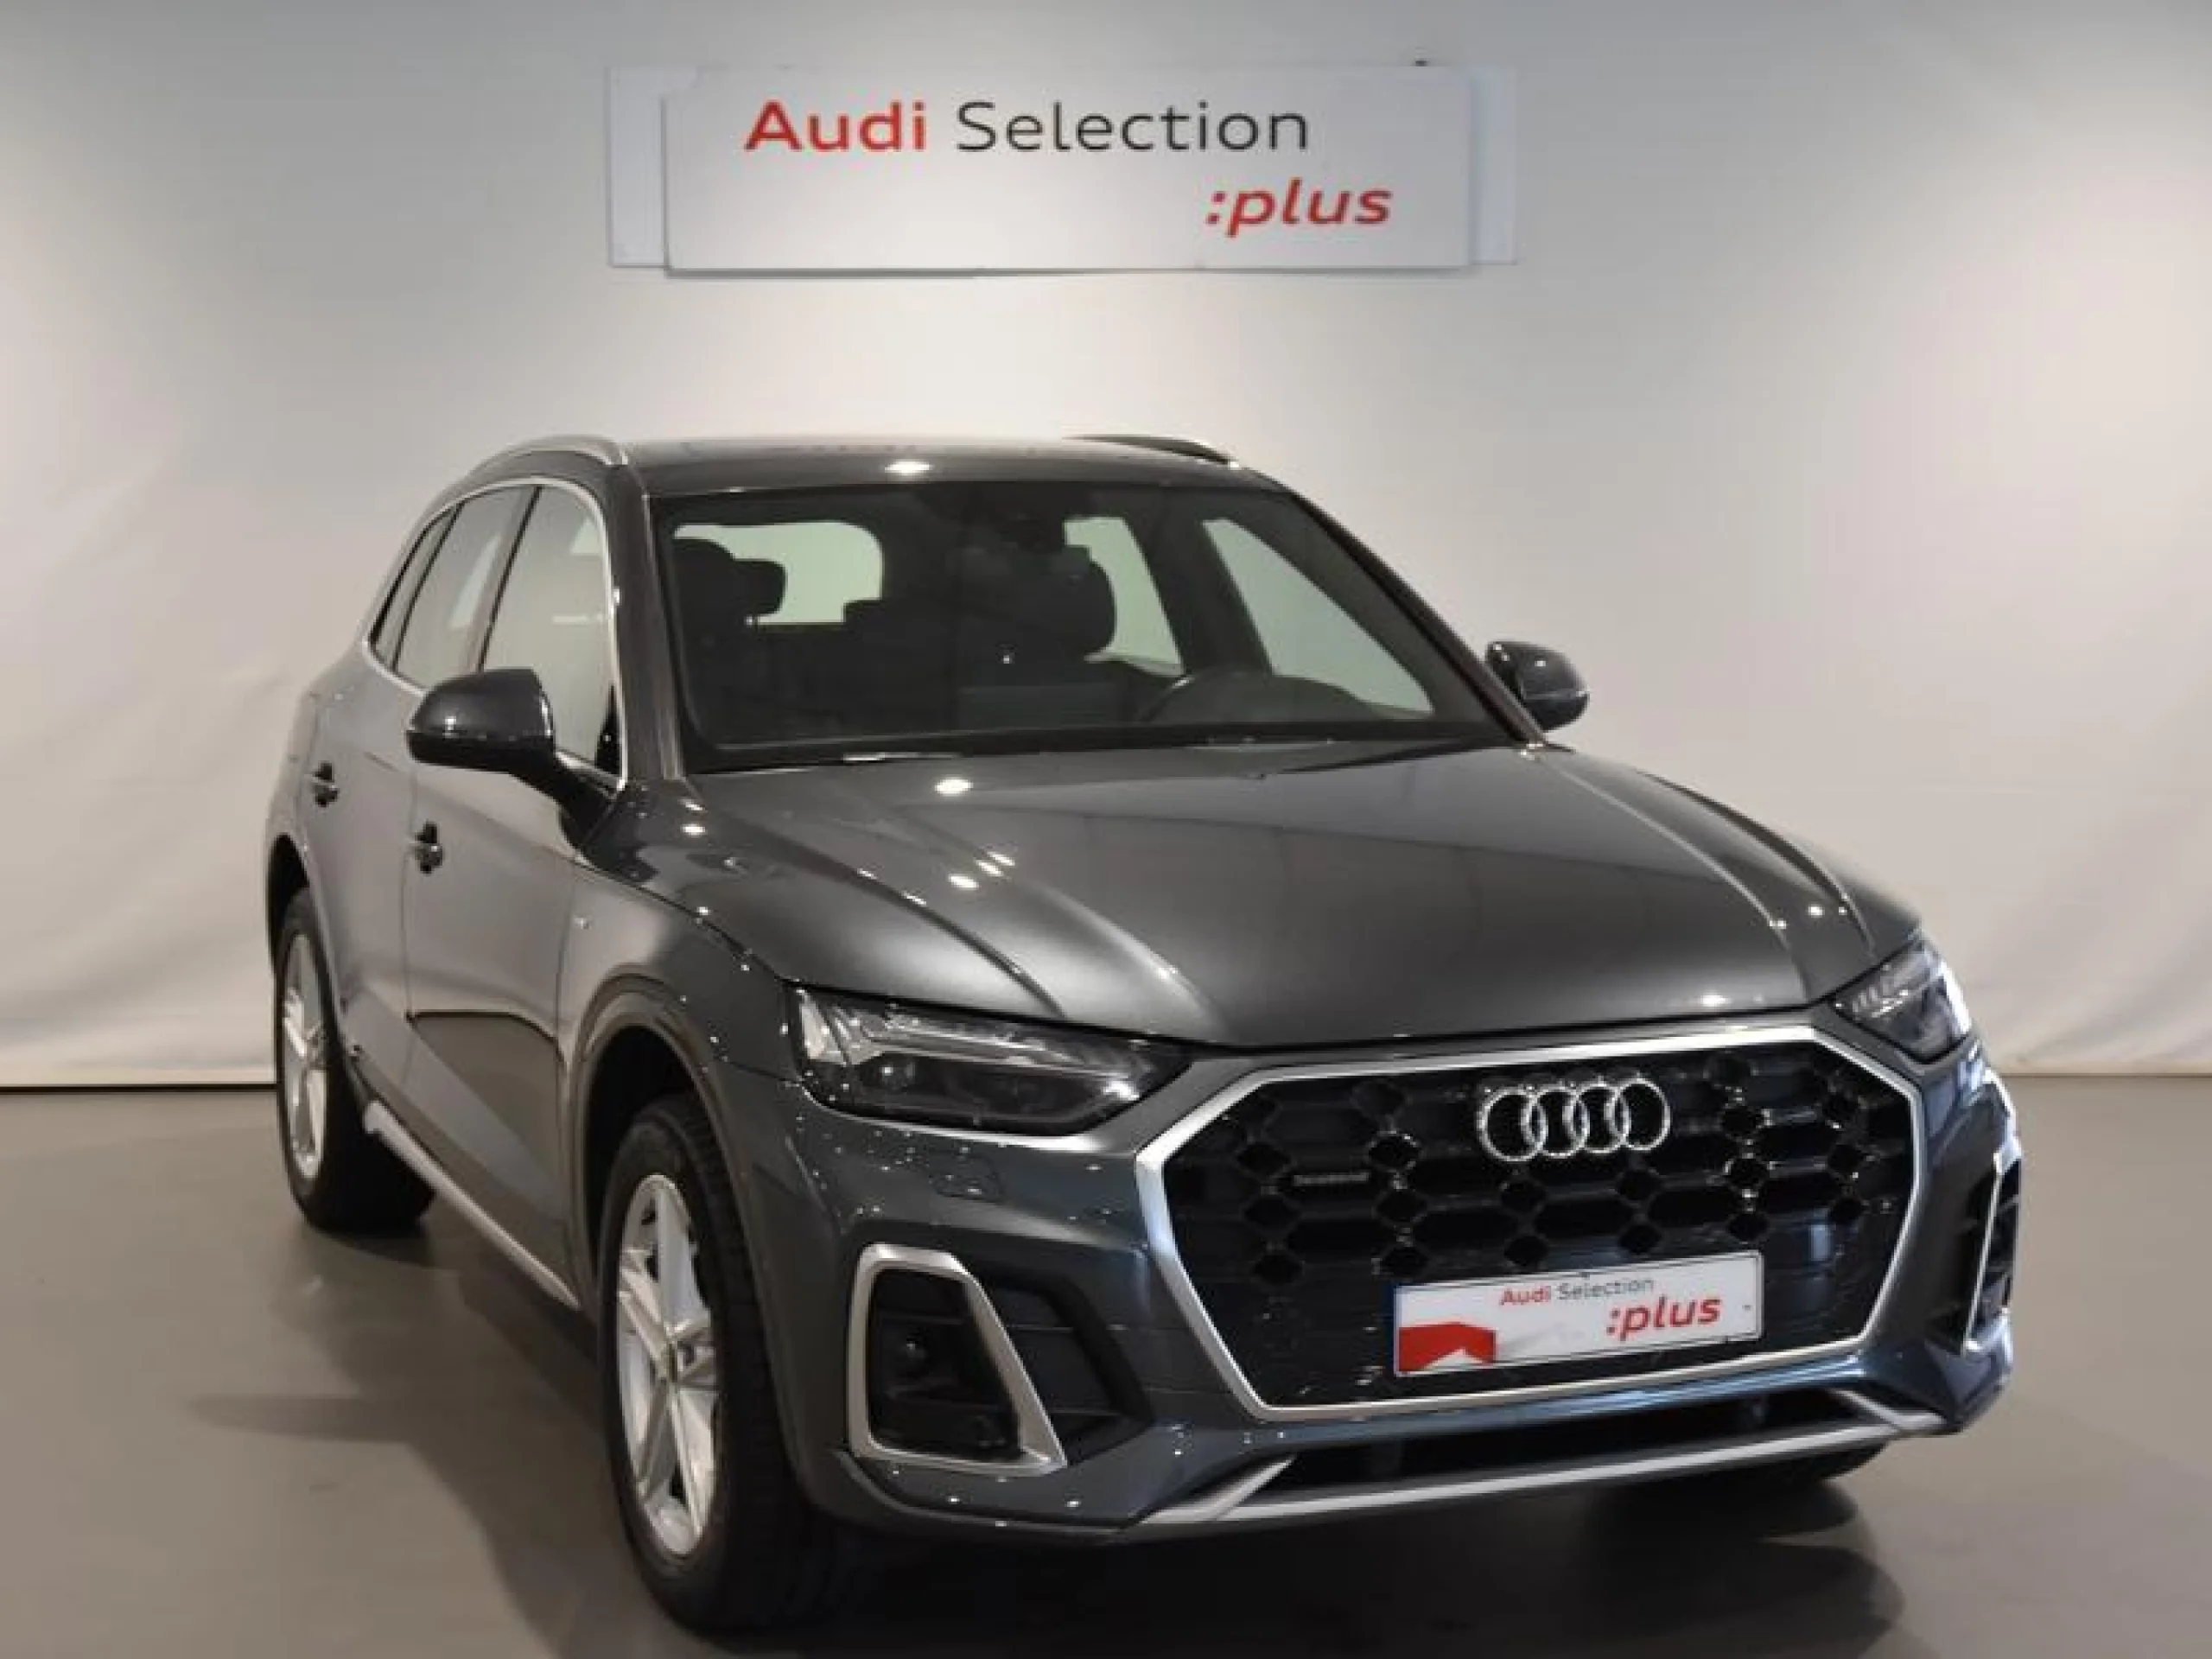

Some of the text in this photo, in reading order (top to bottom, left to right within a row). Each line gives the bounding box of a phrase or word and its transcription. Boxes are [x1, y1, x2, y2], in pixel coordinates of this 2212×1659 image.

[744, 100, 1309, 153] Audi Selection
[1205, 177, 1393, 237] :plus
[1500, 1277, 1655, 1306] Audi Selection
[1606, 1295, 1722, 1341] :plus
